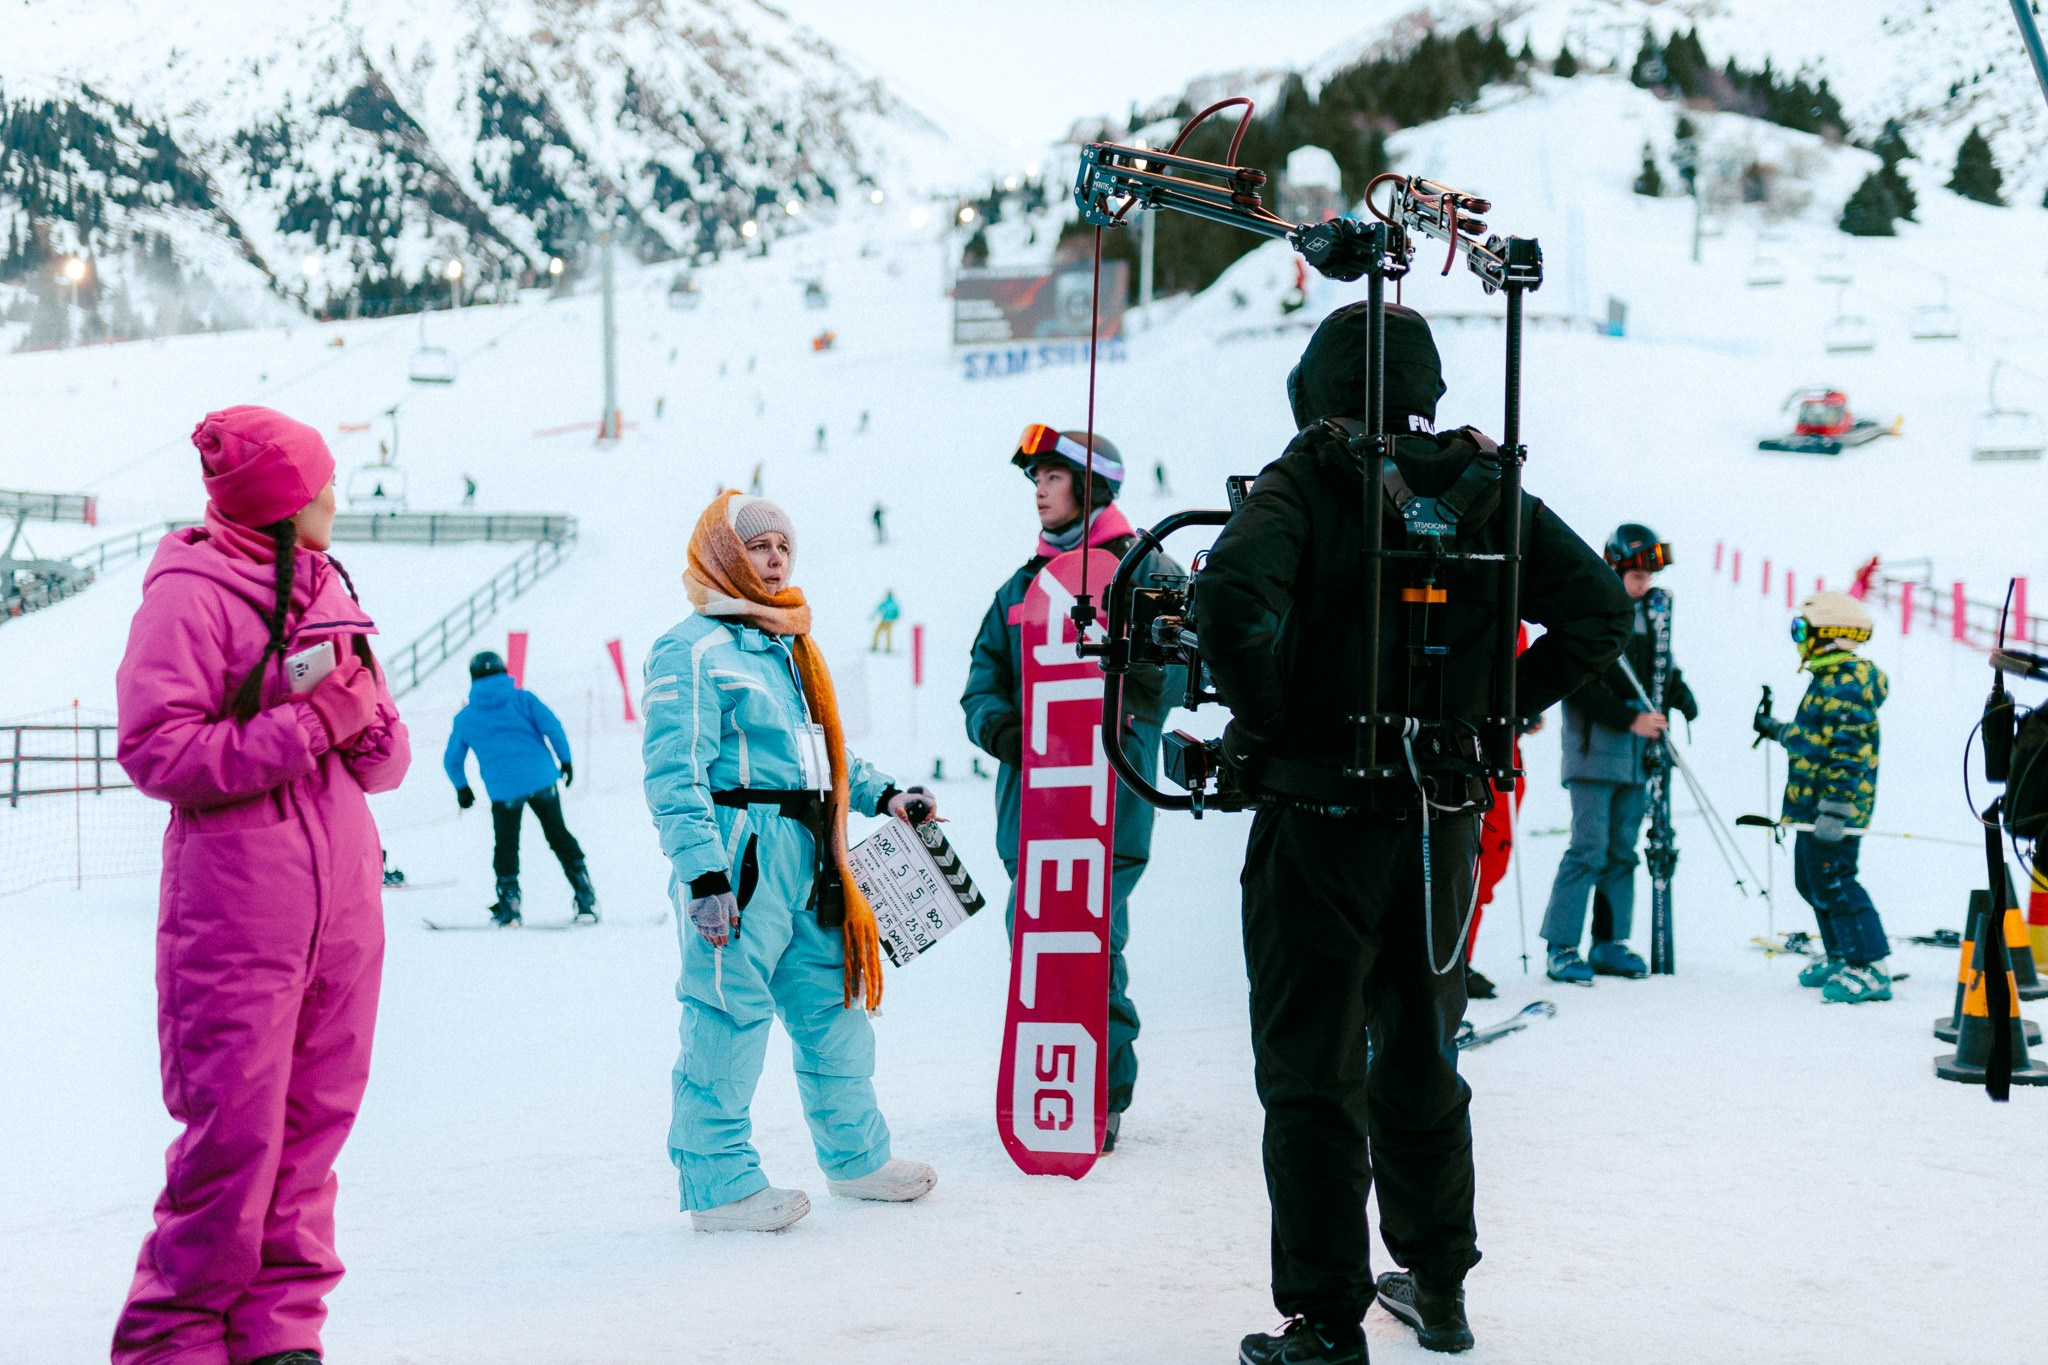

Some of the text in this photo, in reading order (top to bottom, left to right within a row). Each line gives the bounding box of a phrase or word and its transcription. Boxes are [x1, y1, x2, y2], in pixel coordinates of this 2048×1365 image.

[1413, 521, 1448, 530] STEADICAM
[1019, 566, 1109, 1130] ALTEL 5G
[897, 863, 910, 877] 5
[918, 868, 938, 895] ALTEL
[910, 886, 925, 900] 5
[871, 901, 884, 912] A
[878, 913, 894, 930] 25
[926, 908, 943, 930] 800
[905, 917, 928, 947] 25.00
